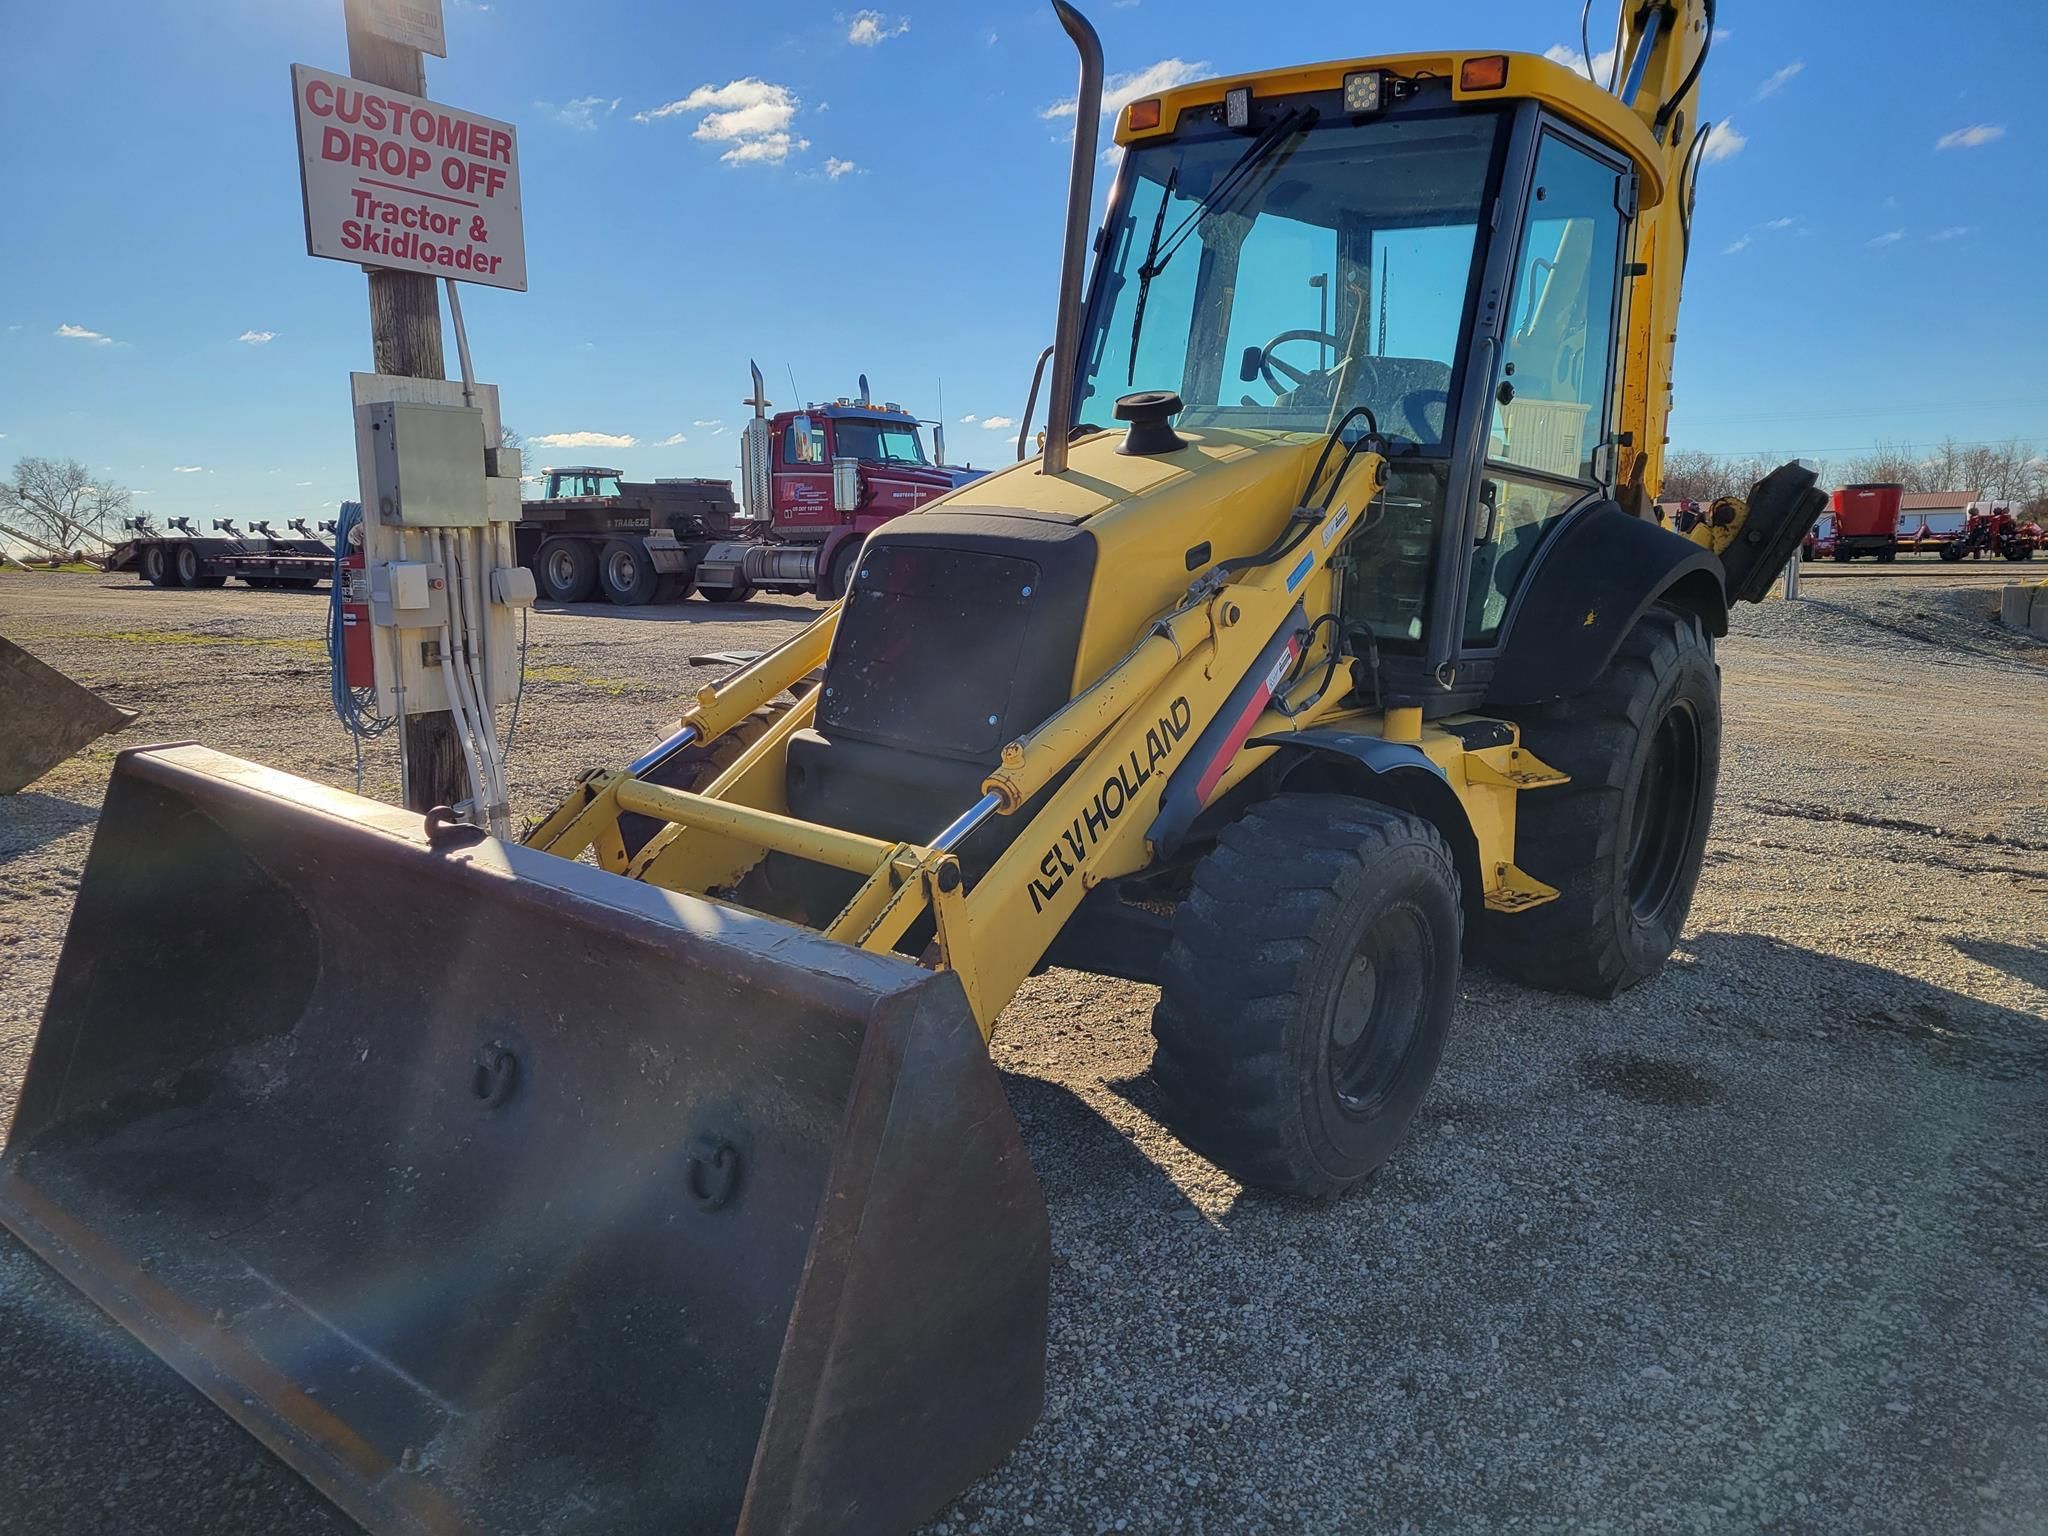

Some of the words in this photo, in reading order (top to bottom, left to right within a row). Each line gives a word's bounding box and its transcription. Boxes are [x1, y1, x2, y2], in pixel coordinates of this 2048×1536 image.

[305, 79, 513, 165] CUSTOMER
[321, 125, 432, 181] DROP
[441, 156, 507, 199] OFF
[340, 219, 502, 275] Skidloader
[351, 188, 461, 237] Tractor
[468, 214, 489, 244] &
[1082, 696, 1191, 844] HOLLAND
